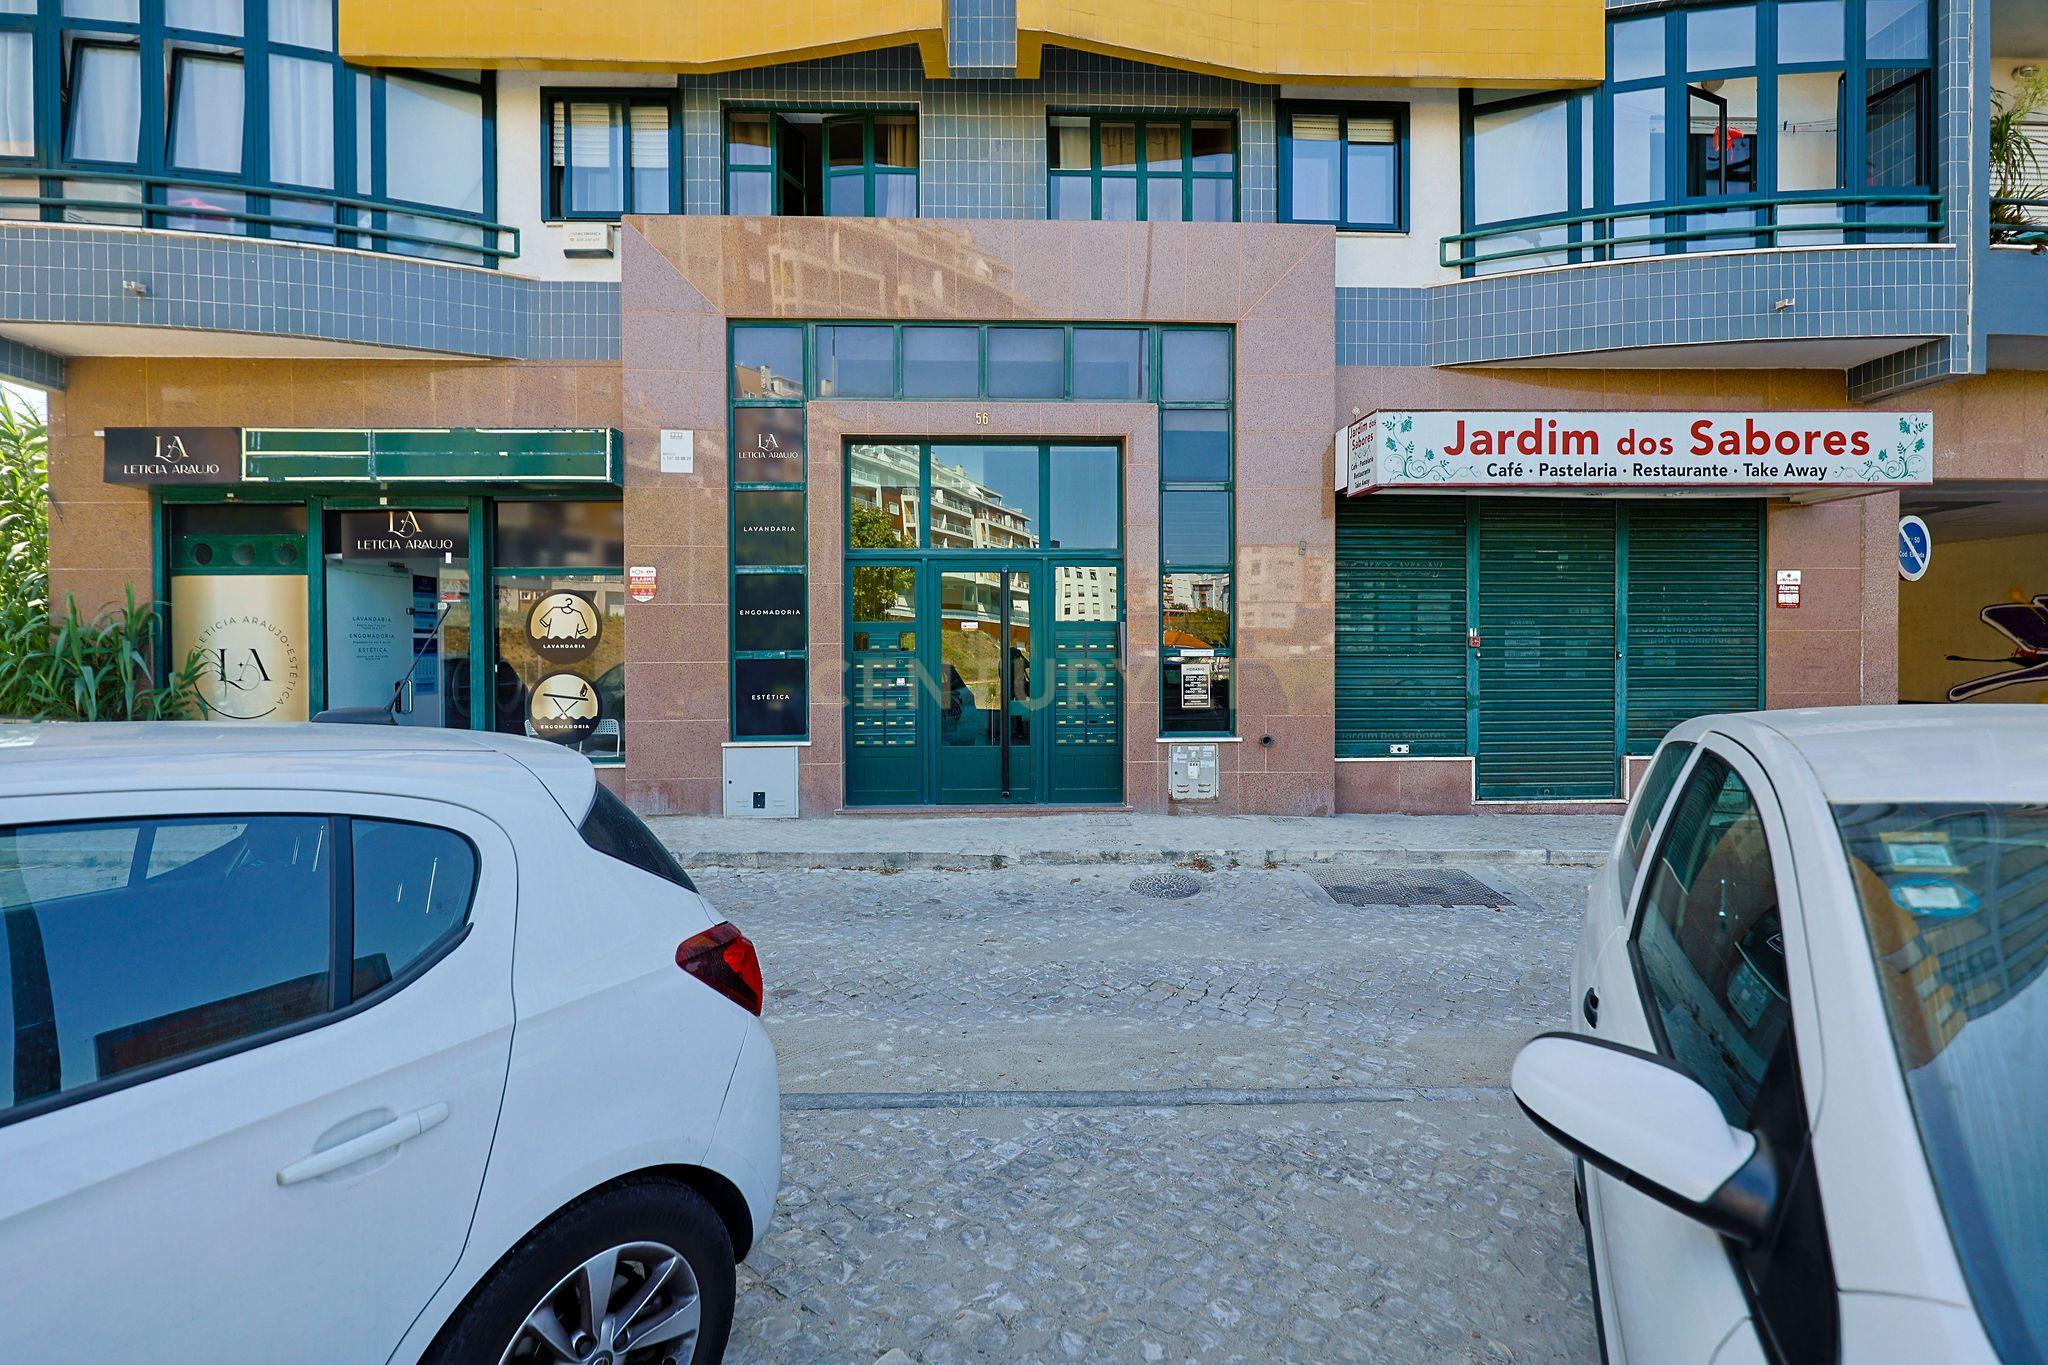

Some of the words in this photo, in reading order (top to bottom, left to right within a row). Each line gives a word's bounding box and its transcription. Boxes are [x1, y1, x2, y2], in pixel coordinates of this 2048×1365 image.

[976, 412, 989, 425] 56
[1349, 421, 1368, 439] Jardim
[1443, 418, 1599, 456] Jardim
[1616, 428, 1674, 456] dos
[1690, 418, 1870, 456] Sabores
[154, 435, 190, 463] LA
[758, 433, 779, 452] LA
[1351, 432, 1374, 451] Sabores
[738, 451, 767, 459] LETICIA
[768, 451, 799, 459] ARAUJO
[123, 464, 168, 475] LETICIA
[171, 464, 220, 475] ARAUJO
[1486, 462, 1523, 477] Café
[1539, 462, 1617, 477] Pastelaria
[1632, 462, 1728, 477] Restaurante
[1743, 463, 1779, 477] Take
[1784, 463, 1828, 481] Away
[387, 511, 423, 538] LA
[357, 539, 401, 550] LETICIA
[405, 539, 453, 550] ARAUJO
[194, 617, 237, 650] LETICIA
[242, 616, 288, 644] ARAUJO
[276, 648, 298, 706] ESTÉTICA
